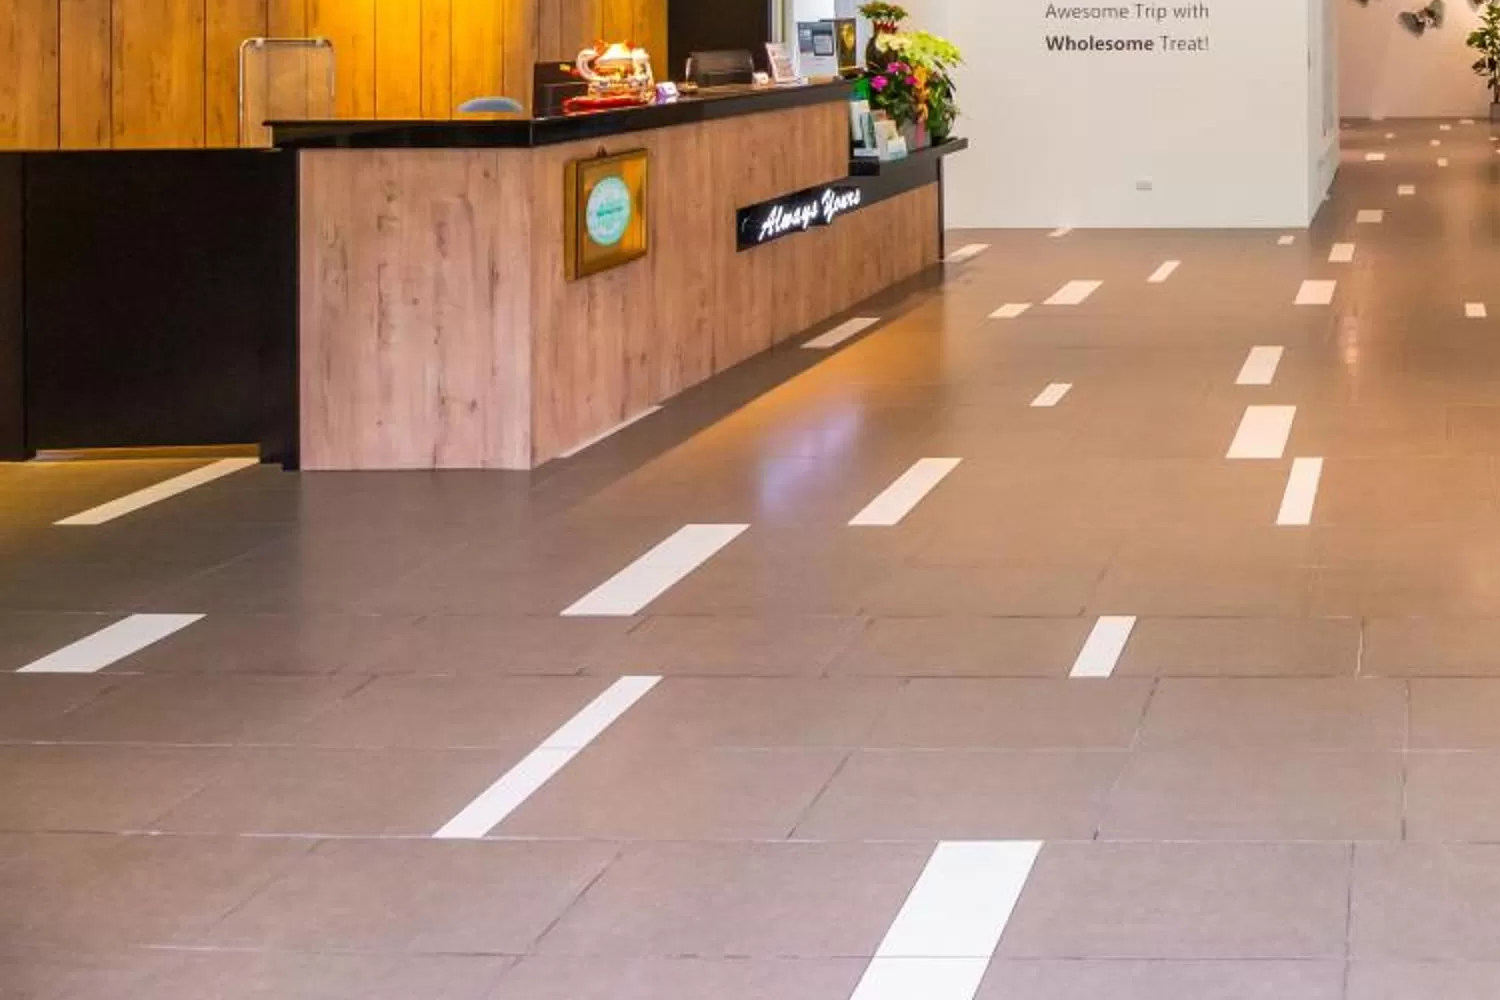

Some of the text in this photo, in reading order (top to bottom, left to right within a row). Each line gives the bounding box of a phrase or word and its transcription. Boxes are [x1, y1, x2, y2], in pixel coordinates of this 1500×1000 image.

[1045, 3, 1209, 22] Awesome Trip with
[1045, 35, 1209, 51] Wholesome Treat!
[758, 187, 861, 241] Always Yours
